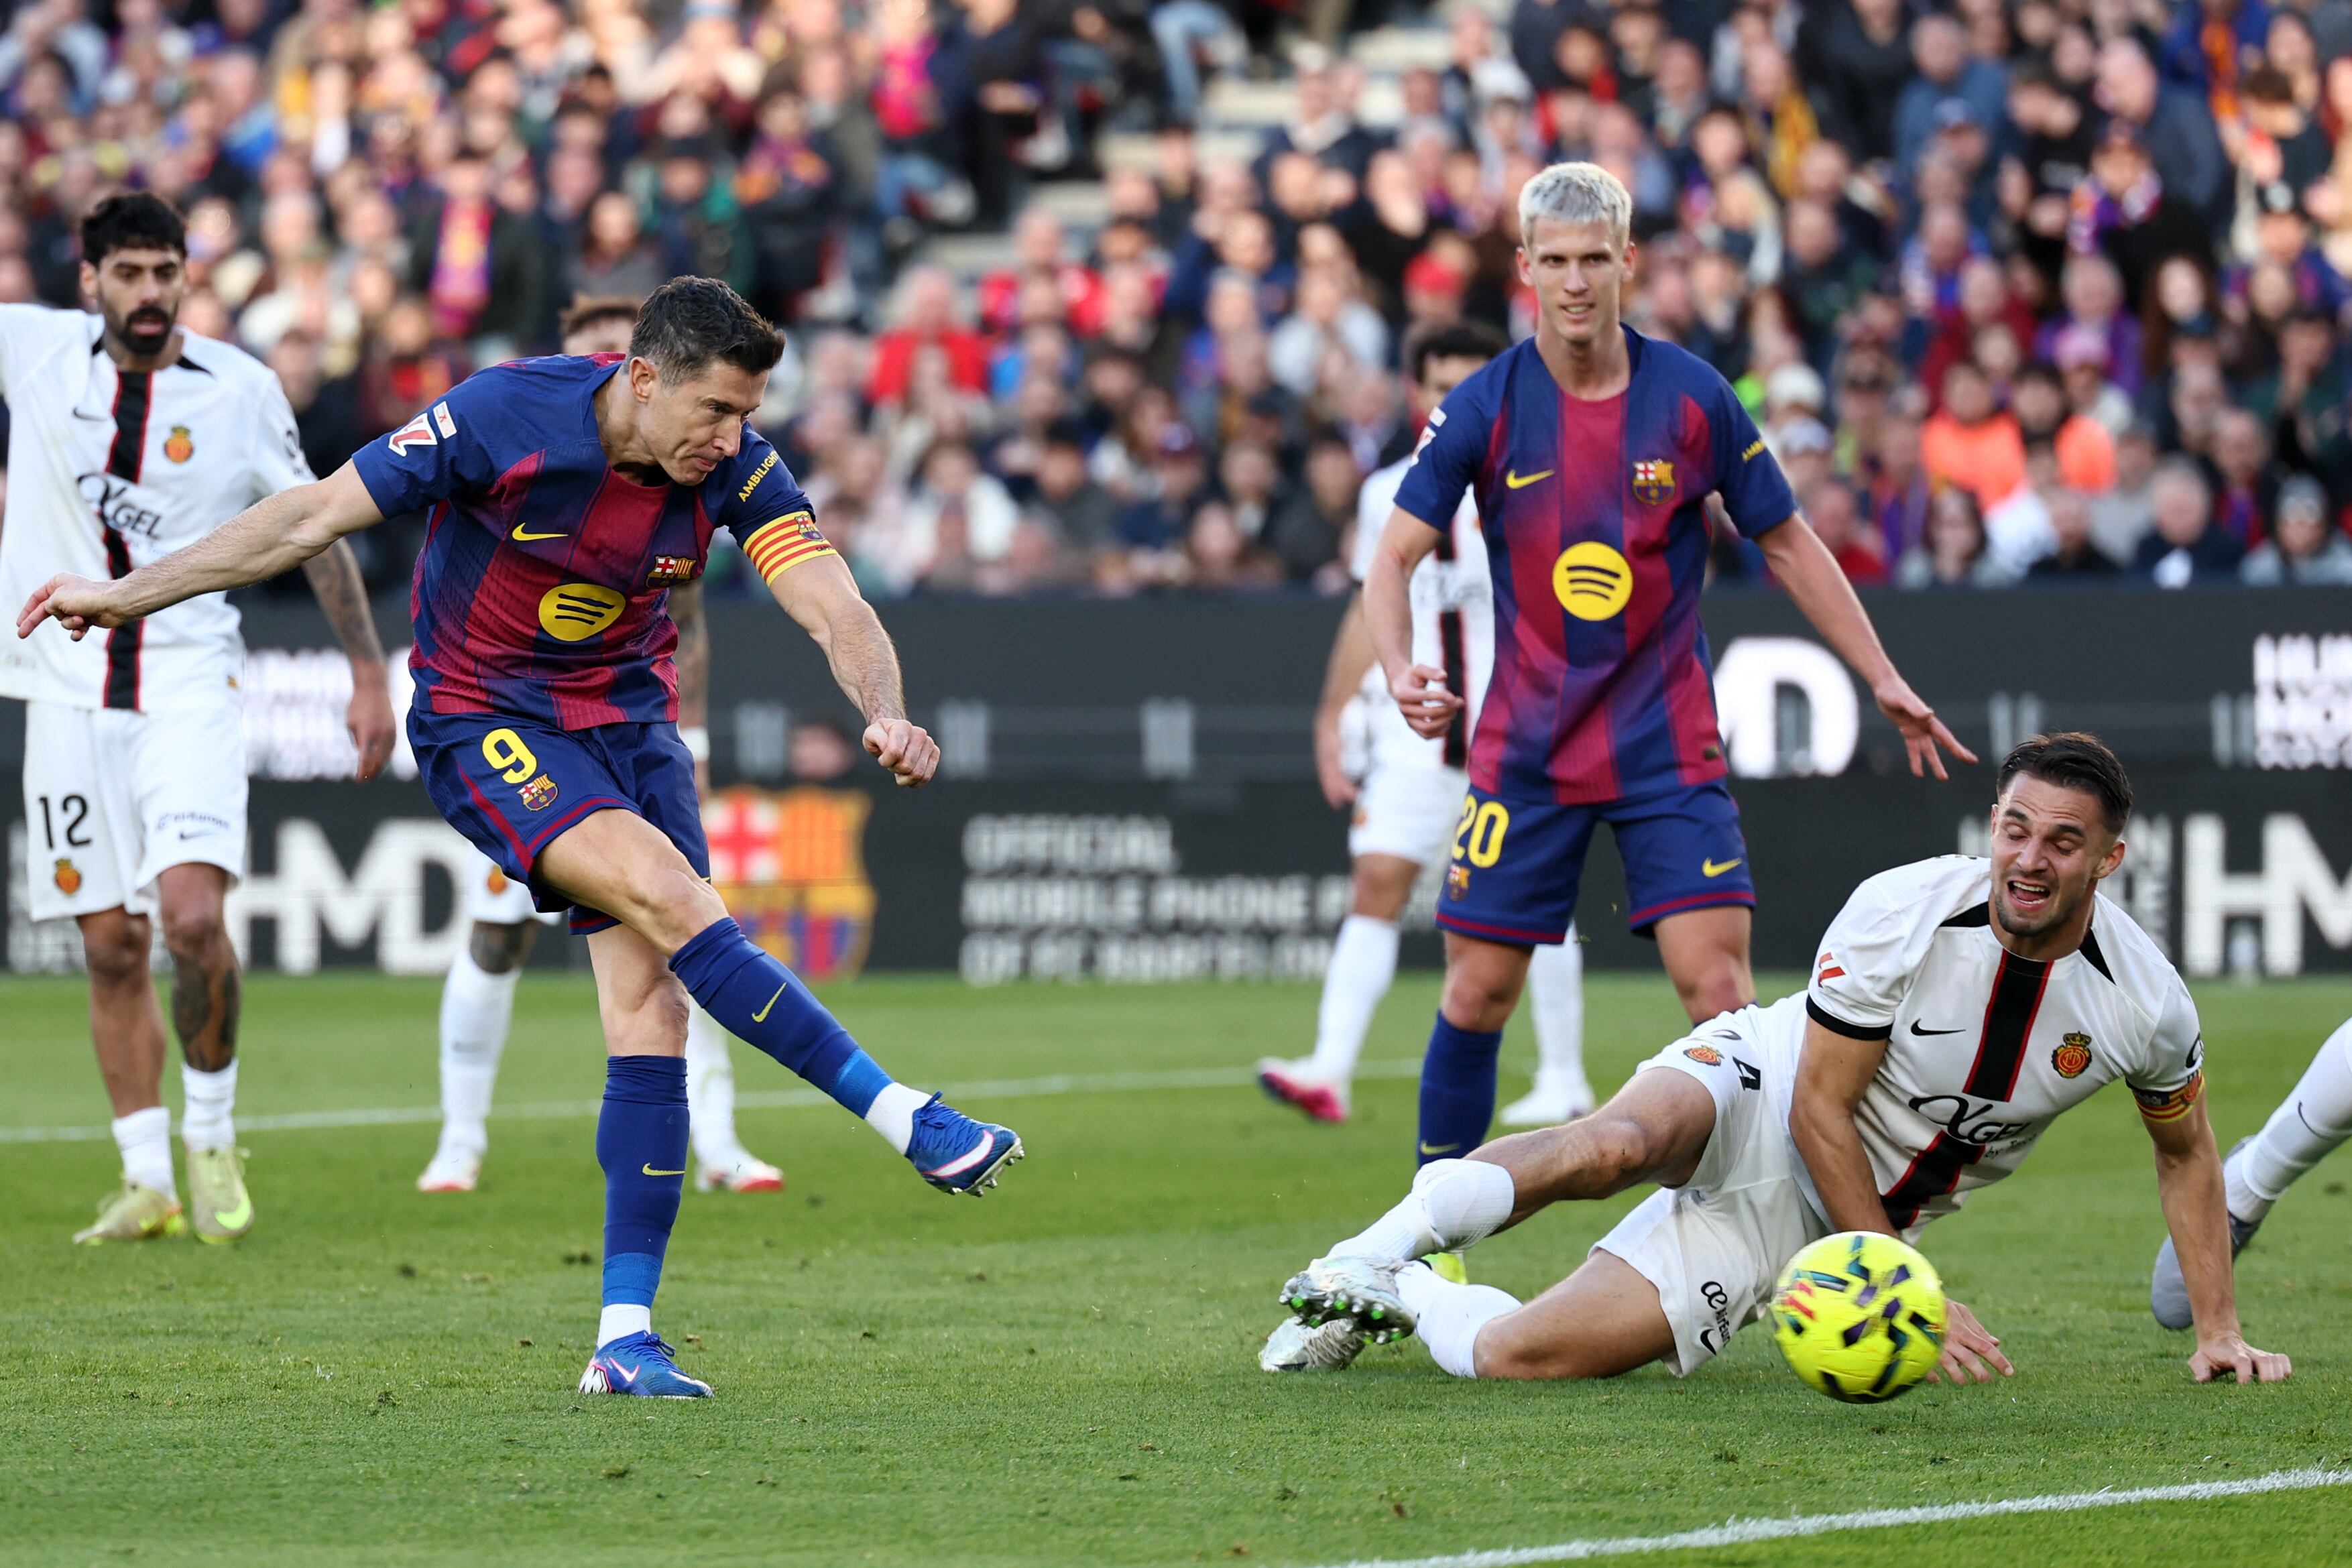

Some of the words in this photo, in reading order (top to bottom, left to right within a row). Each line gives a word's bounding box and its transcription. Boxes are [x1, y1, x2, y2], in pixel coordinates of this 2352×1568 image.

[482, 728, 537, 784] 9
[40, 794, 92, 850] 12
[1452, 793, 1510, 868] 20
